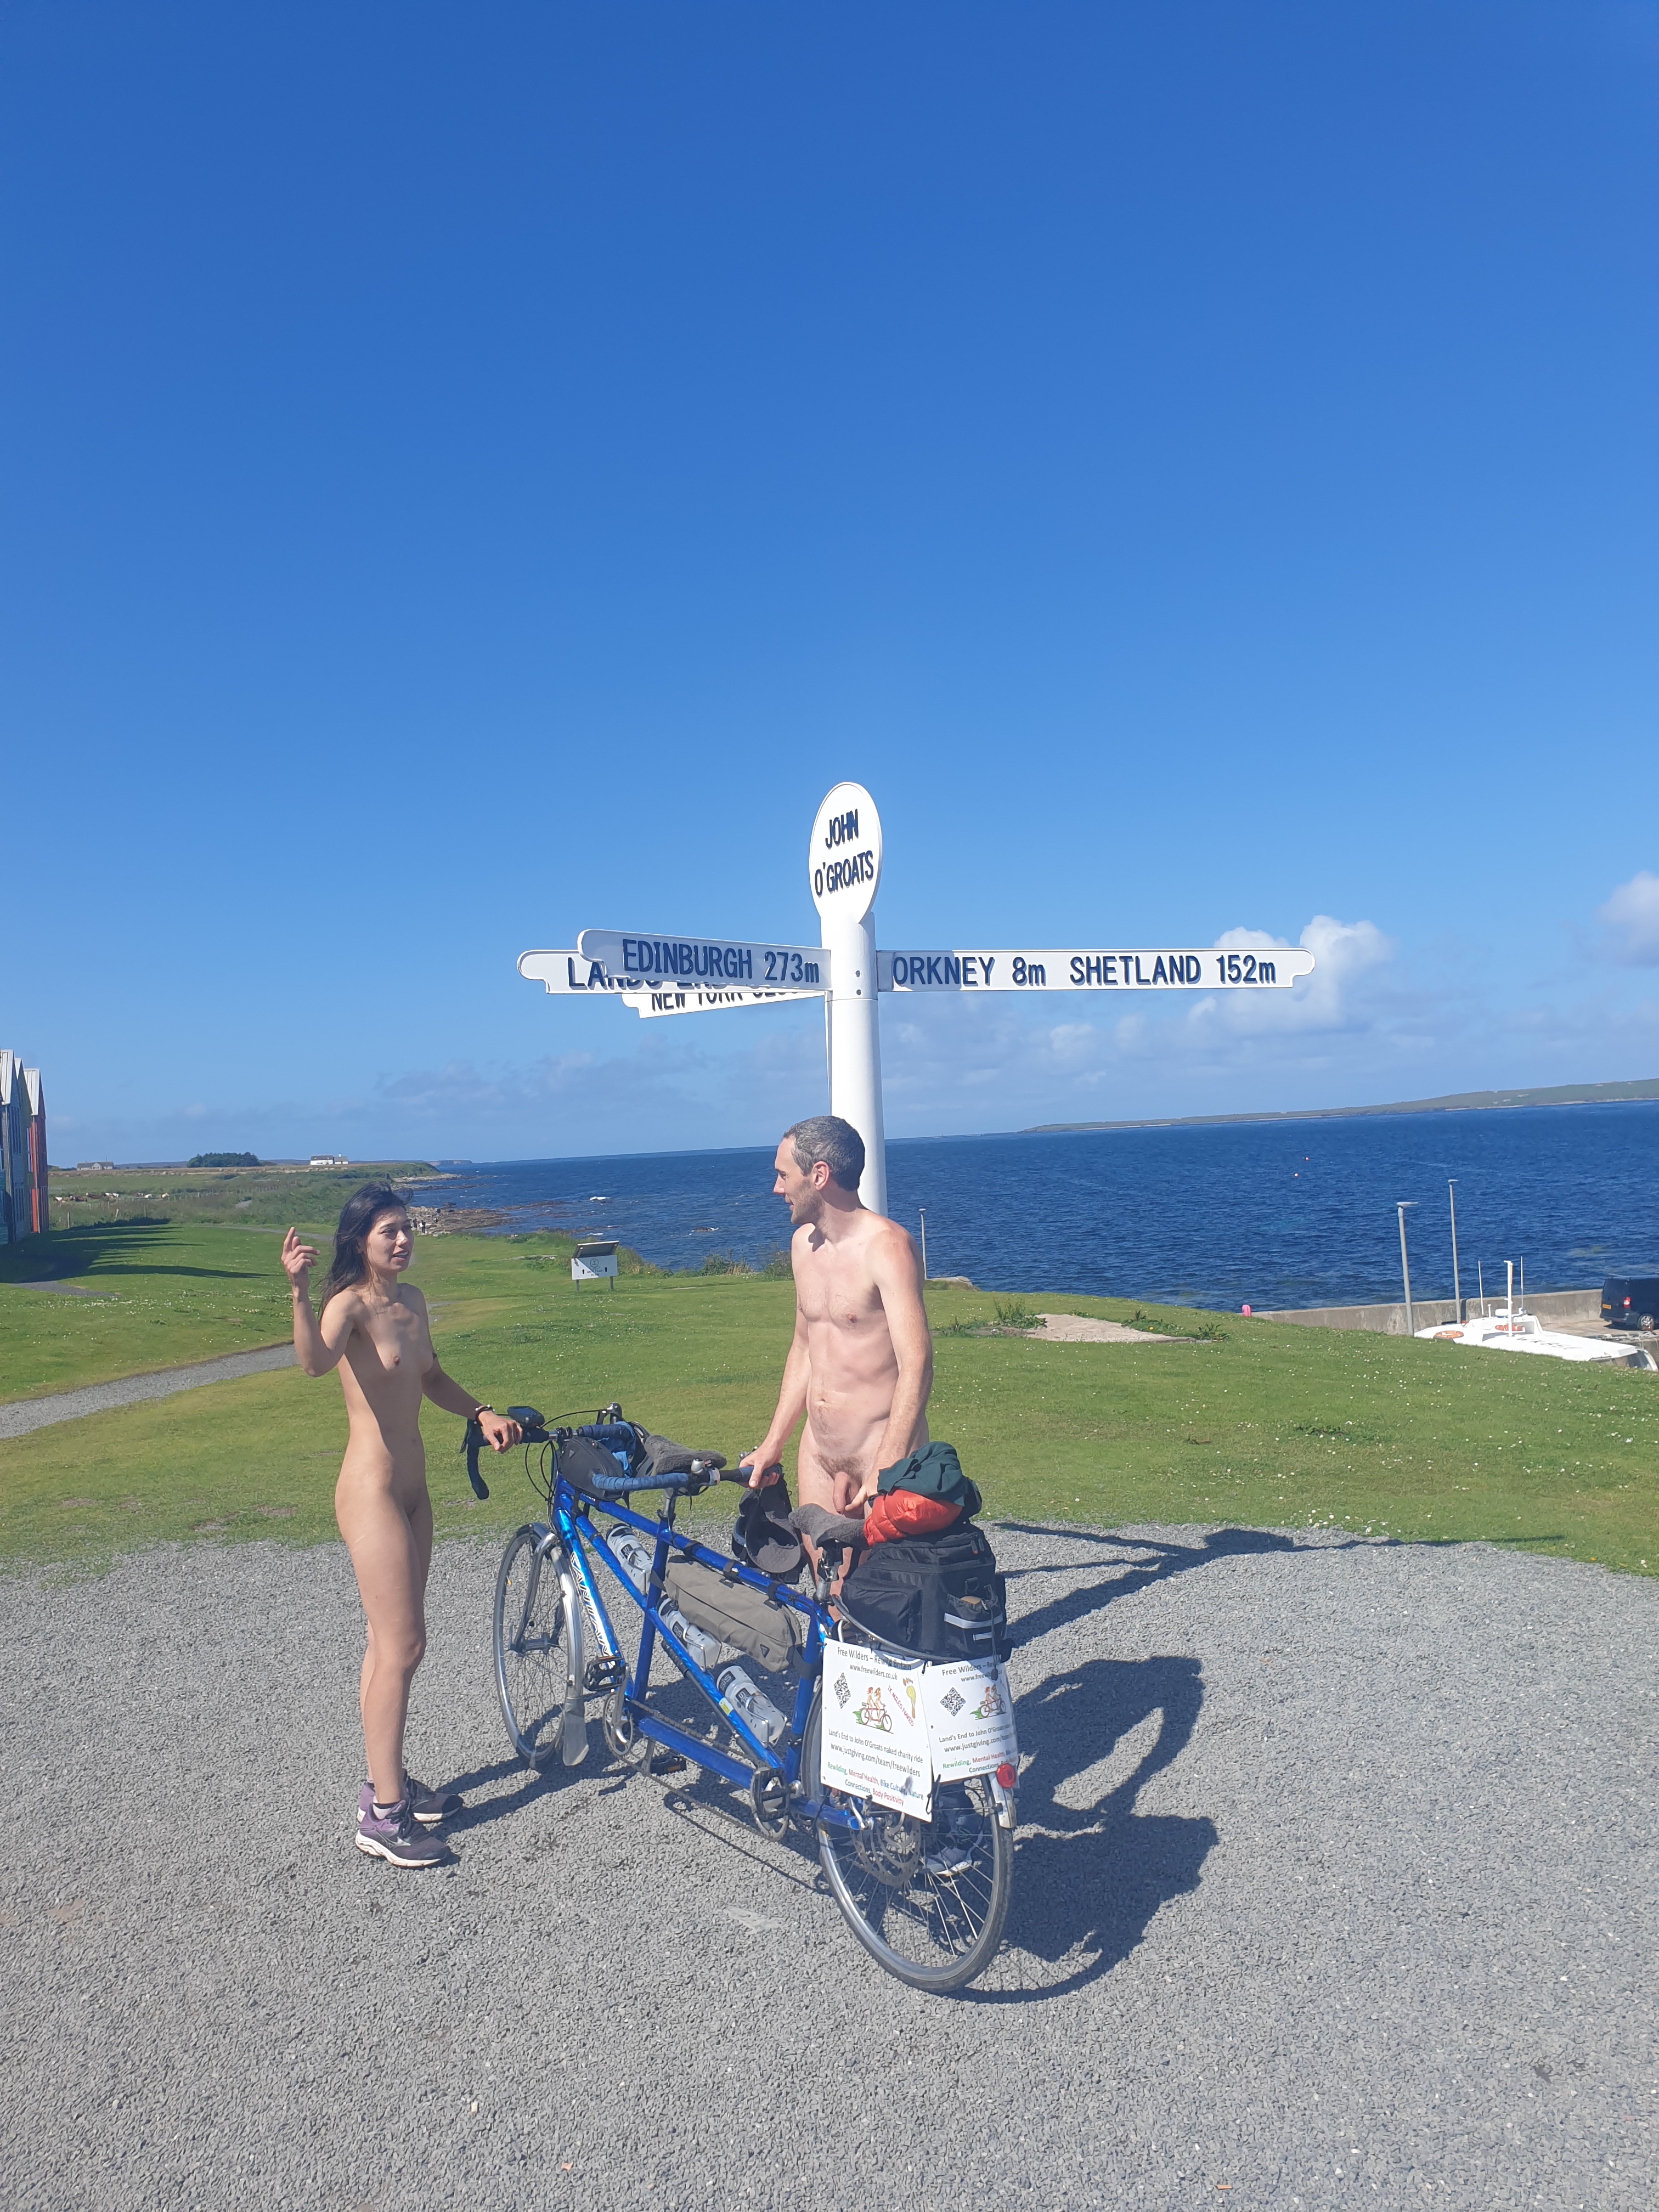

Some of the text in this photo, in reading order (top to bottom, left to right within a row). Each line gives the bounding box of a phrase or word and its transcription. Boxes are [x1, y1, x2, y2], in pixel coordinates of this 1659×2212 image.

[825, 808, 859, 849] JOHN
[814, 850, 874, 896] O'GROATS
[622, 939, 752, 979] EDINBURGH
[764, 951, 820, 983] 273m
[892, 954, 1276, 986] ORKNEY 8m SHETLAND 152m
[837, 1647, 848, 1657] Free
[849, 1649, 868, 1661] Wilders
[874, 1656, 893, 1667] Rewild
[893, 1659, 912, 1671] Britain
[849, 1663, 898, 1680] www.freewilders.co.uk
[958, 1664, 982, 1673] Wilders
[828, 1728, 840, 1738] Land's
[854, 1736, 864, 1746] John
[884, 1746, 897, 1756] naked
[898, 1750, 913, 1762] charity
[914, 1754, 923, 1764] ride
[939, 1734, 956, 1743] Land's
[943, 1759, 971, 1769] Rewilding,
[972, 1754, 990, 1763] Mental
[849, 1768, 864, 1779] Mental
[908, 1788, 924, 1800] Nature
[872, 1788, 883, 1799] Body
[884, 1792, 904, 1807] Positivity
